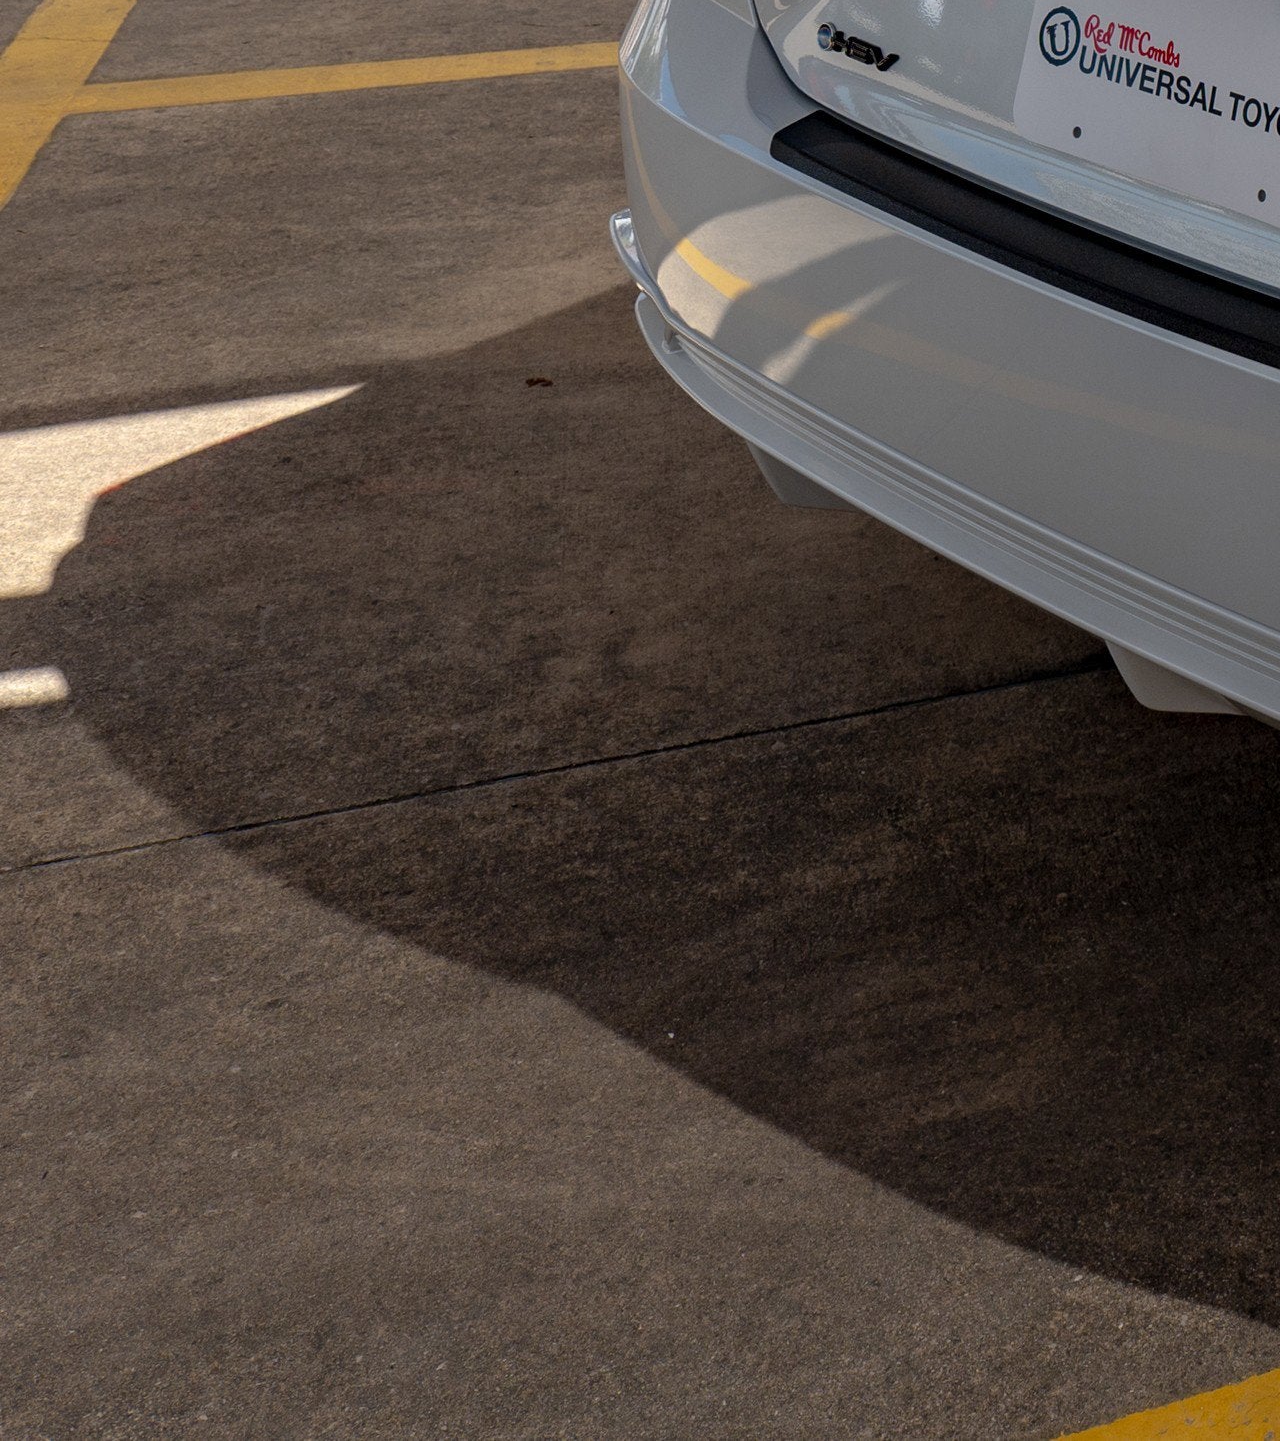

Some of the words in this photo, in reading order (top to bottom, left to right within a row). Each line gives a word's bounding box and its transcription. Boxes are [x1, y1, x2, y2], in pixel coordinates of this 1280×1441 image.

[1084, 14, 1115, 54] Red
[1118, 23, 1180, 69] McCombs
[1078, 45, 1223, 117] UNIVERSAL
